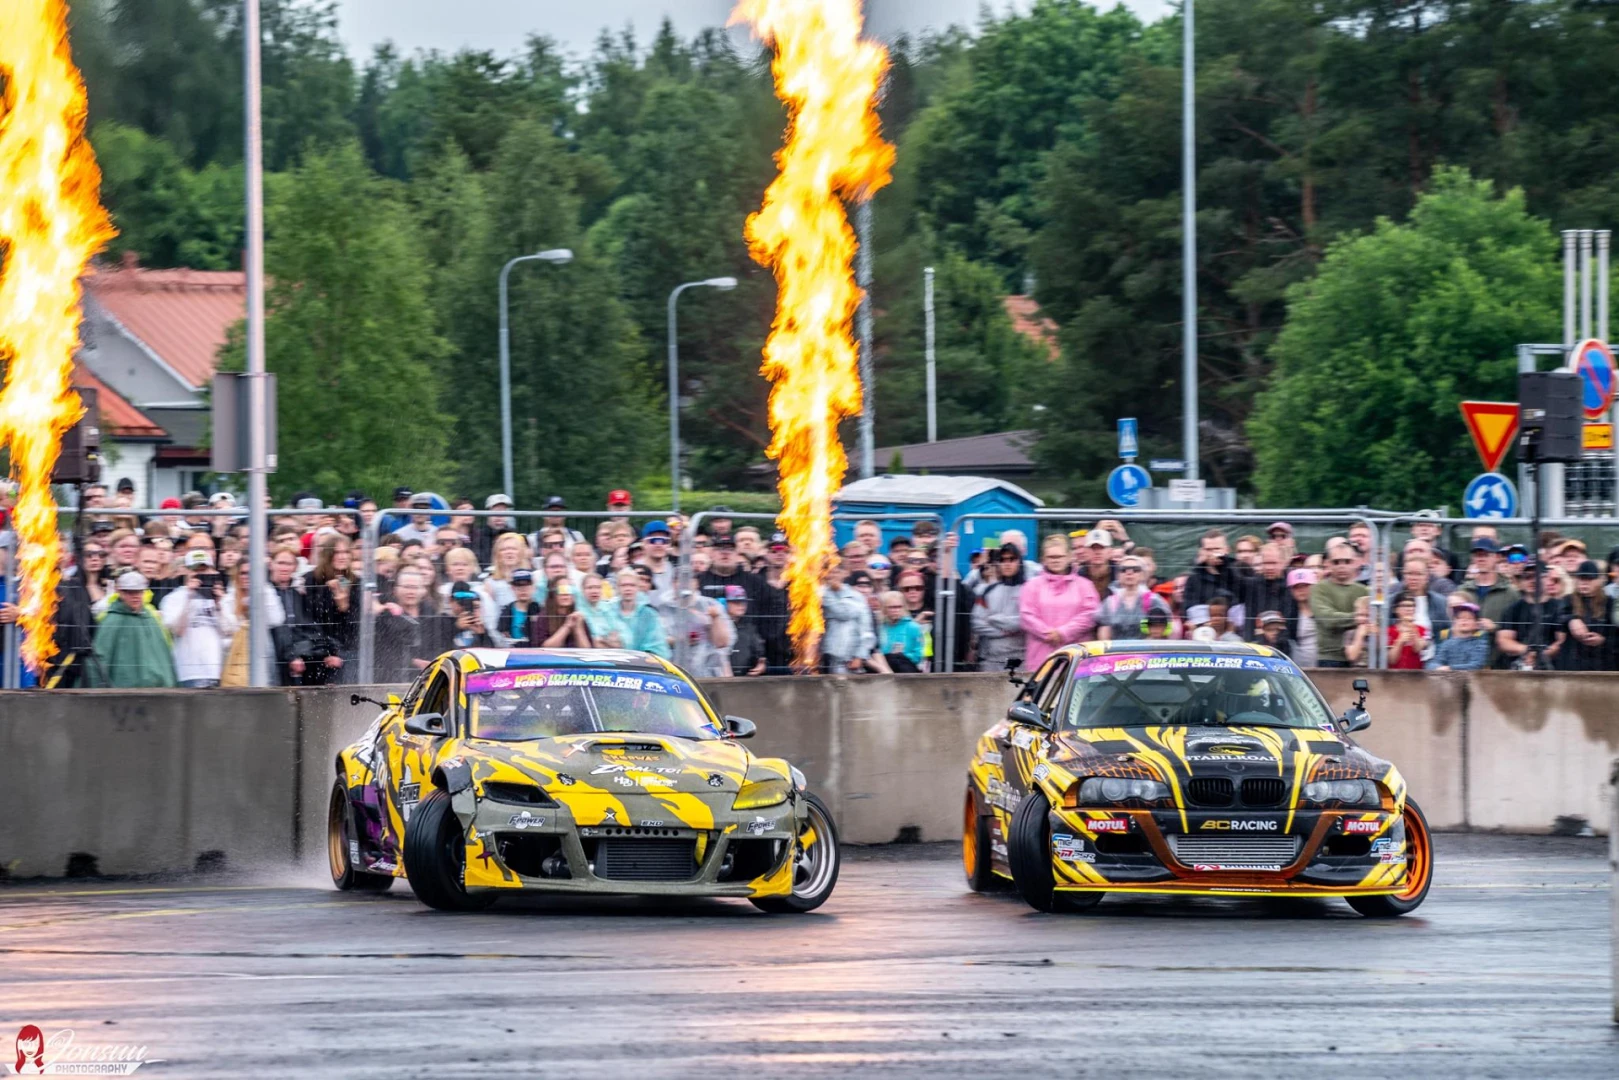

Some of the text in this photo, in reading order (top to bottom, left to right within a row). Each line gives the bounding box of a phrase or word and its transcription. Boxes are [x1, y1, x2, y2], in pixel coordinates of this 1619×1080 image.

[1148, 656, 1242, 666] IDEAPARK PRO
[549, 674, 643, 687] IDEAPARK PRO
[592, 681, 641, 690] CHALLENGE
[1087, 820, 1126, 830] MOTUL
[1347, 821, 1380, 832] MOTUL
